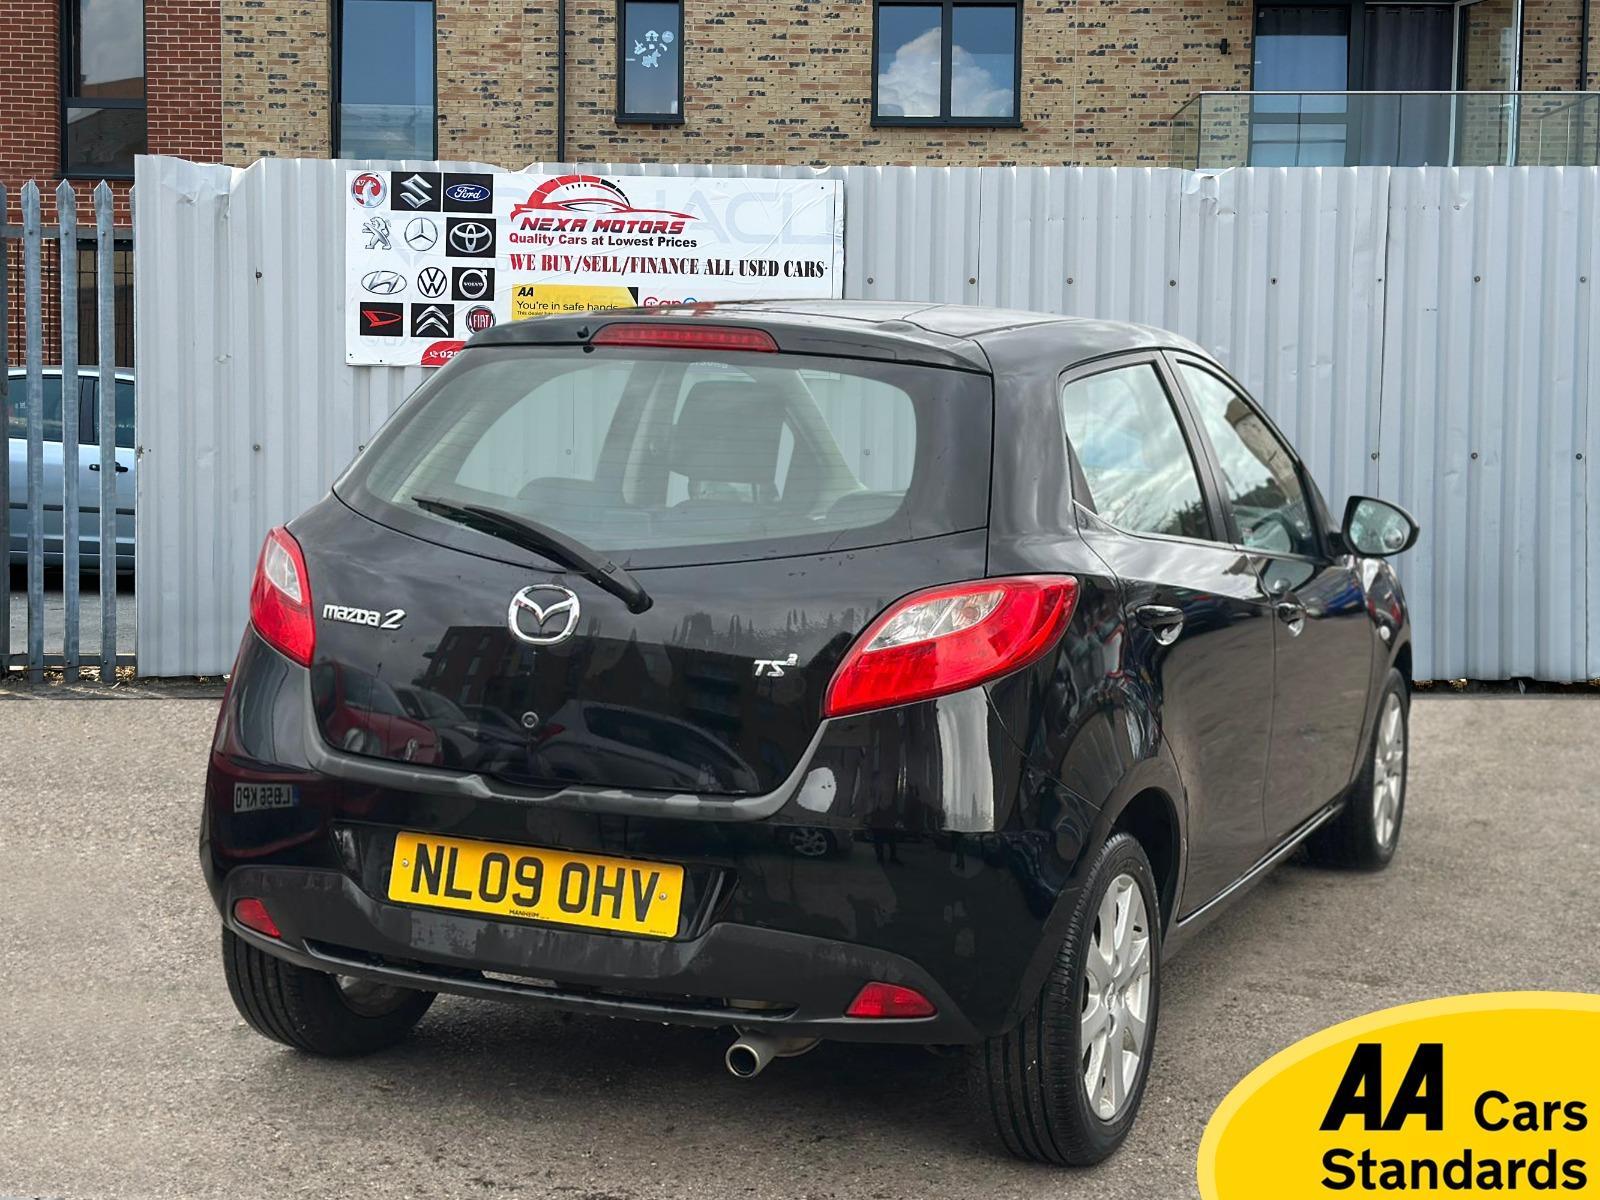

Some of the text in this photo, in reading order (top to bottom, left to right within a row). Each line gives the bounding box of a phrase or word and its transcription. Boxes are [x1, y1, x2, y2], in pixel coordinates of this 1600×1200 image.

[454, 186, 481, 199] Ford
[520, 217, 686, 235] NEXA MOTORS
[509, 233, 697, 248] Quality Cars at Lowest Prices
[509, 253, 536, 271] WE
[541, 254, 699, 276] BUY/SELL/FINANCE
[704, 258, 734, 276] ALL
[739, 259, 780, 277] USED
[784, 260, 825, 278] CARS
[517, 286, 534, 297] AA
[516, 300, 549, 310] You're
[552, 301, 560, 310] in
[563, 302, 585, 311] safe
[473, 314, 490, 328] FIAT
[410, 843, 660, 922] NL09 OHV
